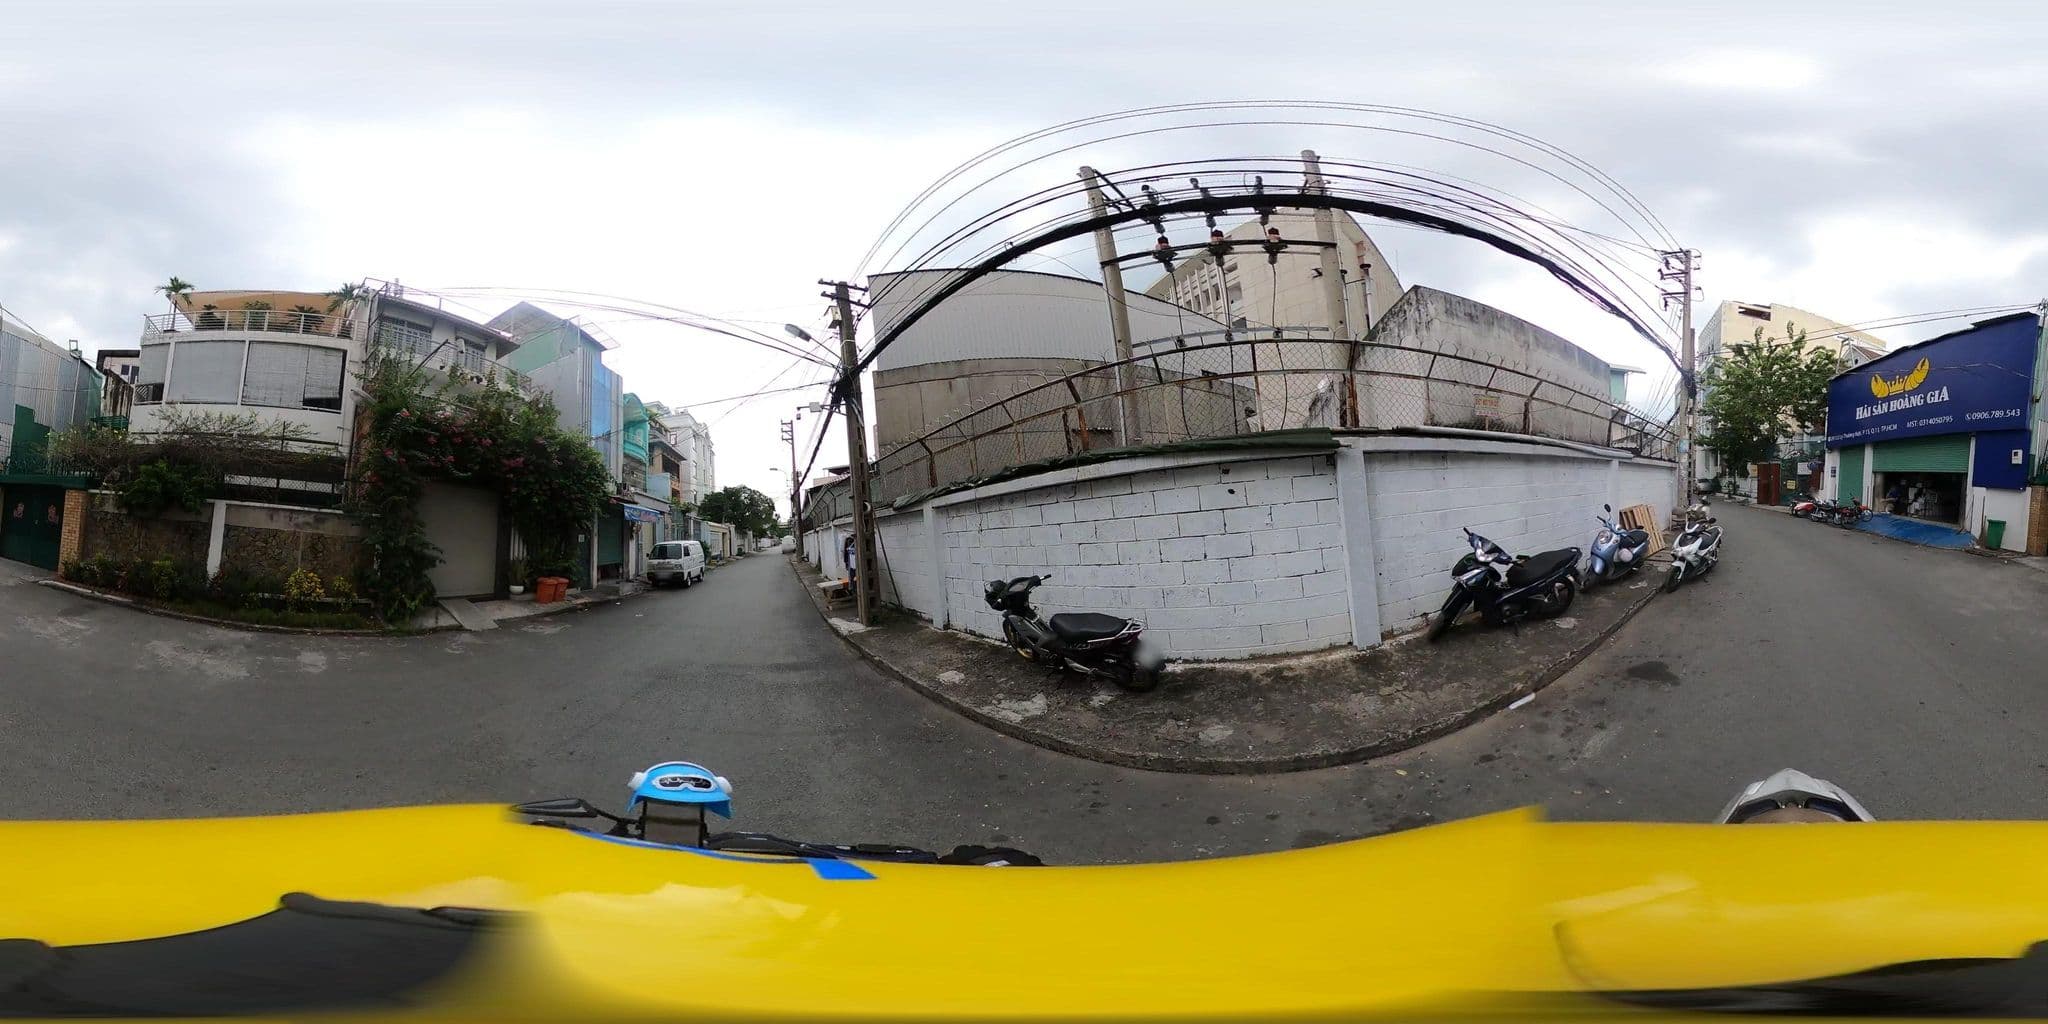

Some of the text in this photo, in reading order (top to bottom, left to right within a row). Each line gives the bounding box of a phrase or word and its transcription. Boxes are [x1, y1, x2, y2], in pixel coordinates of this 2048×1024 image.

[1889, 394, 1924, 412] HOÀNG
[1926, 385, 1949, 404] GIA
[1972, 408, 2021, 420] 0906.789.543
